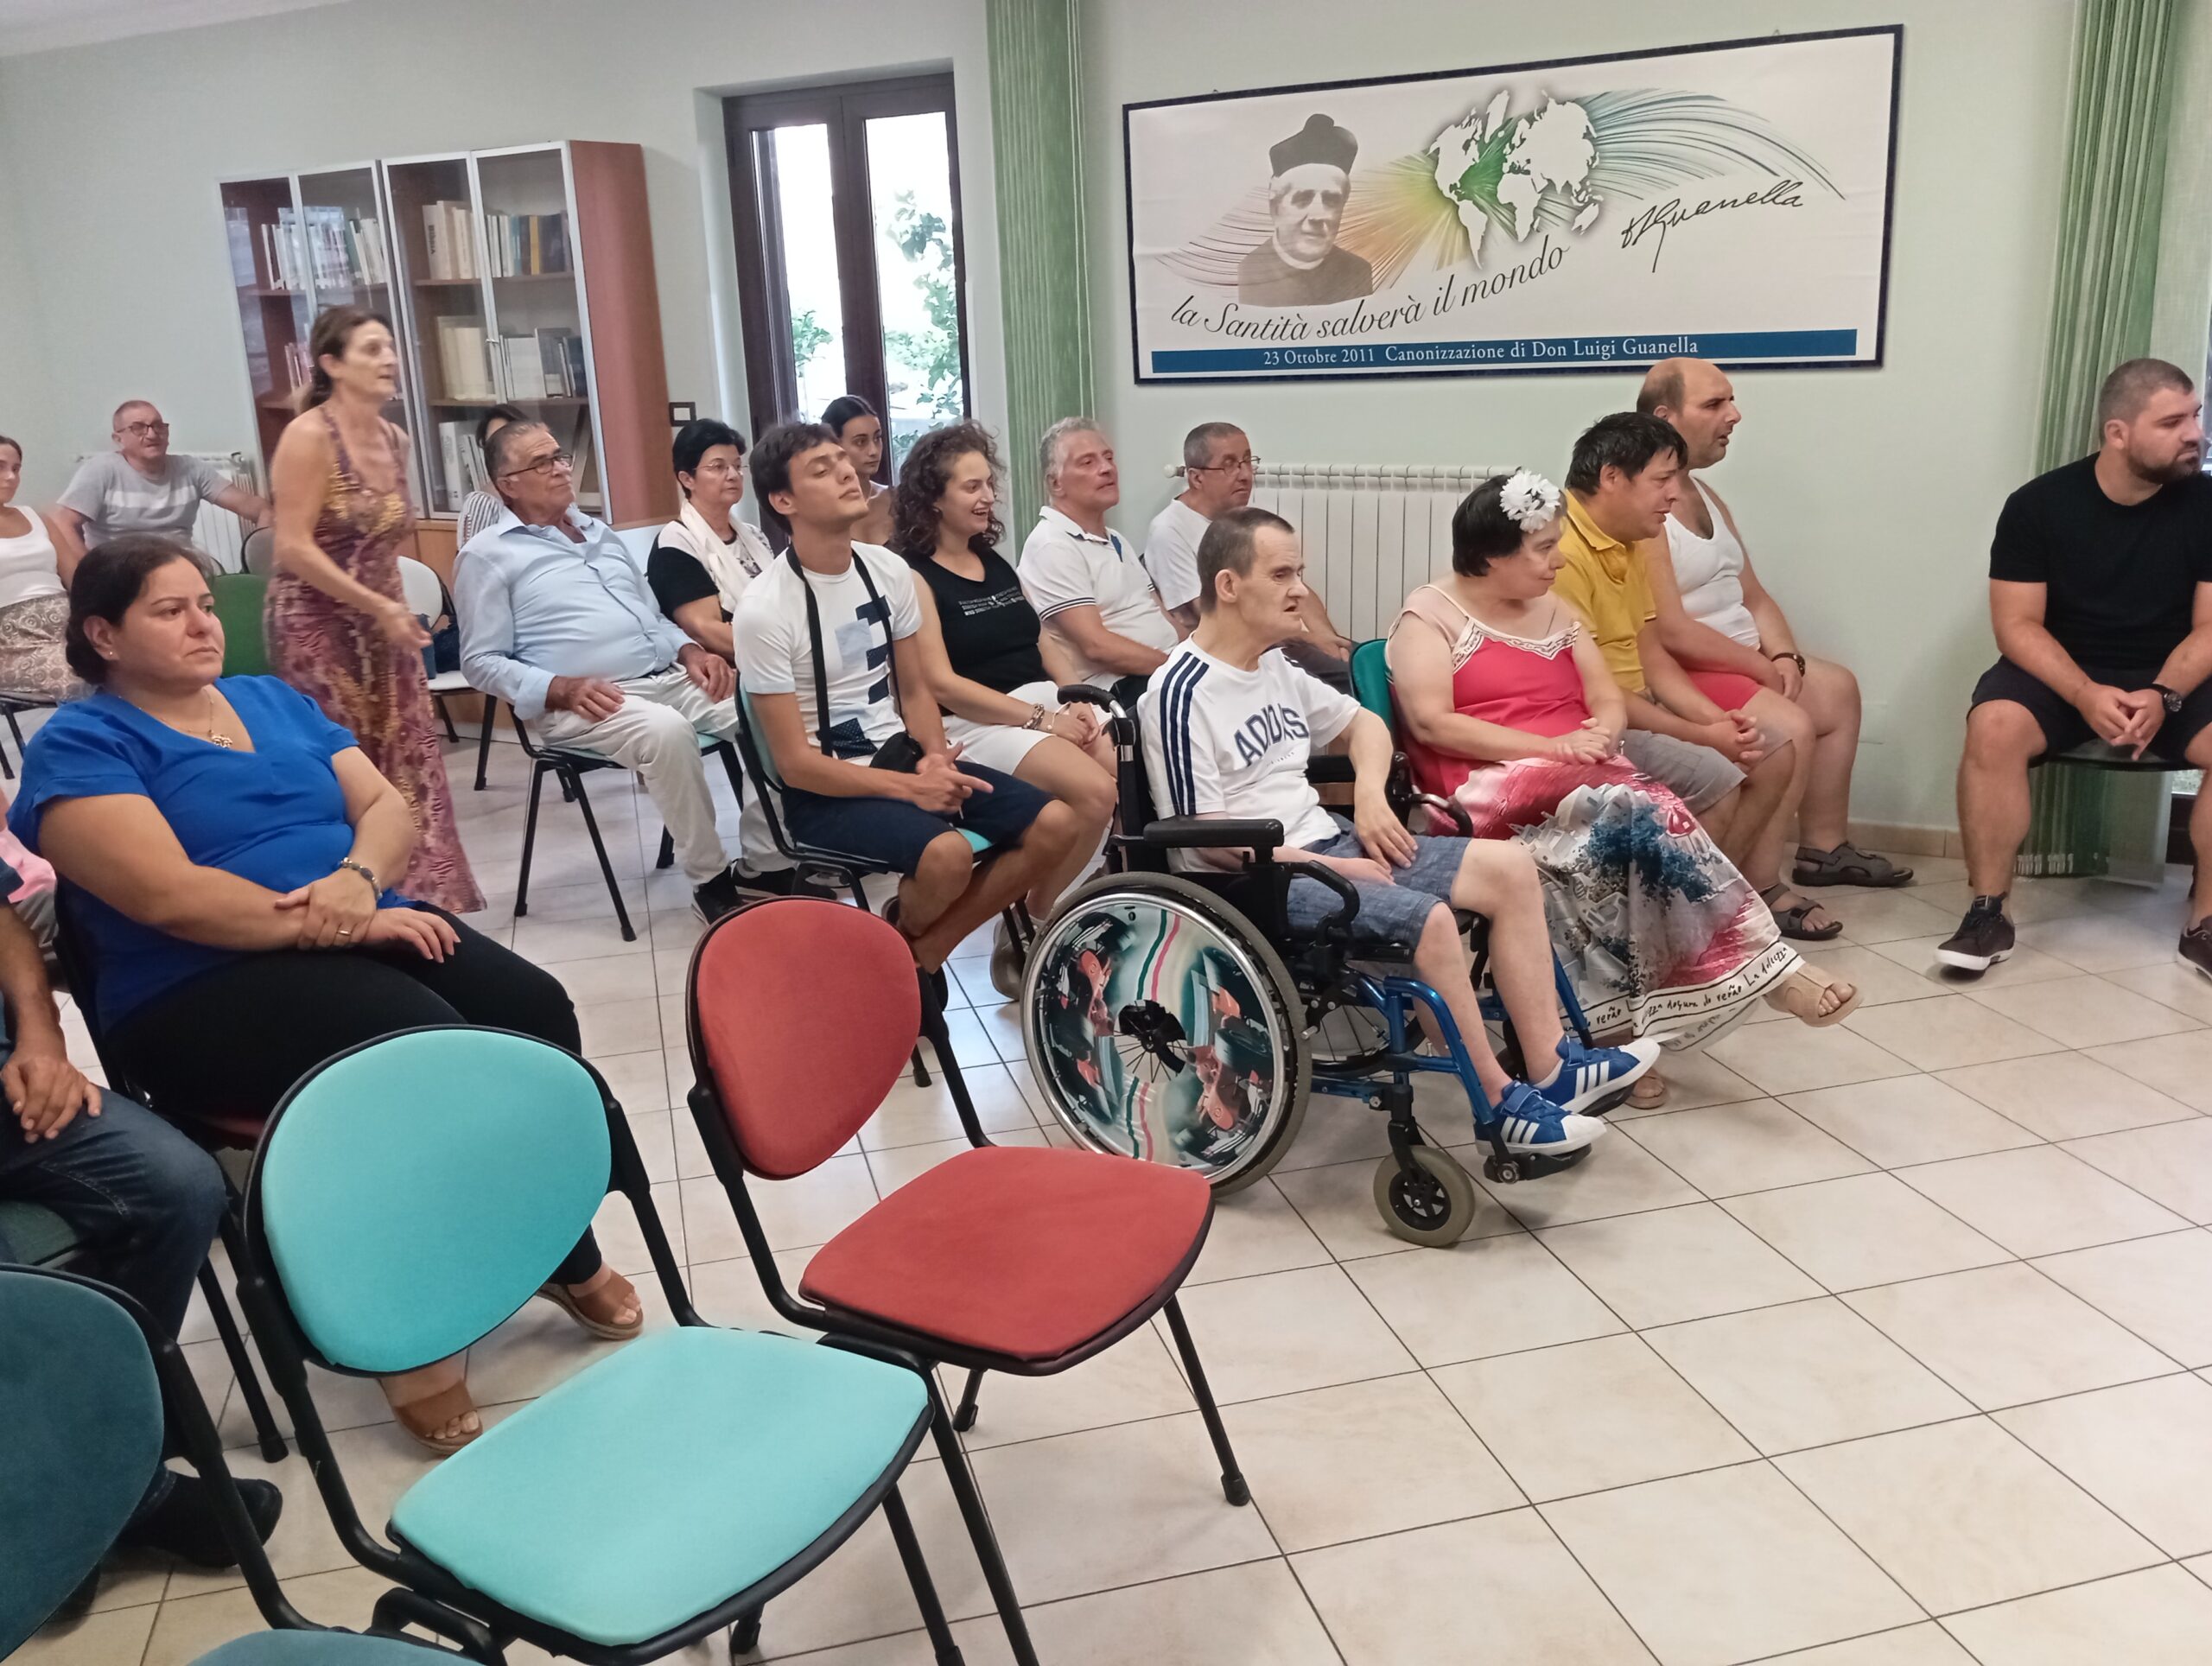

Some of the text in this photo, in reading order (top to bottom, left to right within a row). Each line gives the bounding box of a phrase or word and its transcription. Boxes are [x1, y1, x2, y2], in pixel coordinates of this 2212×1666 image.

[1171, 234, 1571, 340] la Santità salverà il mondo
[1264, 336, 1699, 366] 23 Ottobre 2011 Canonizzazione di Don Luigi Guanella
